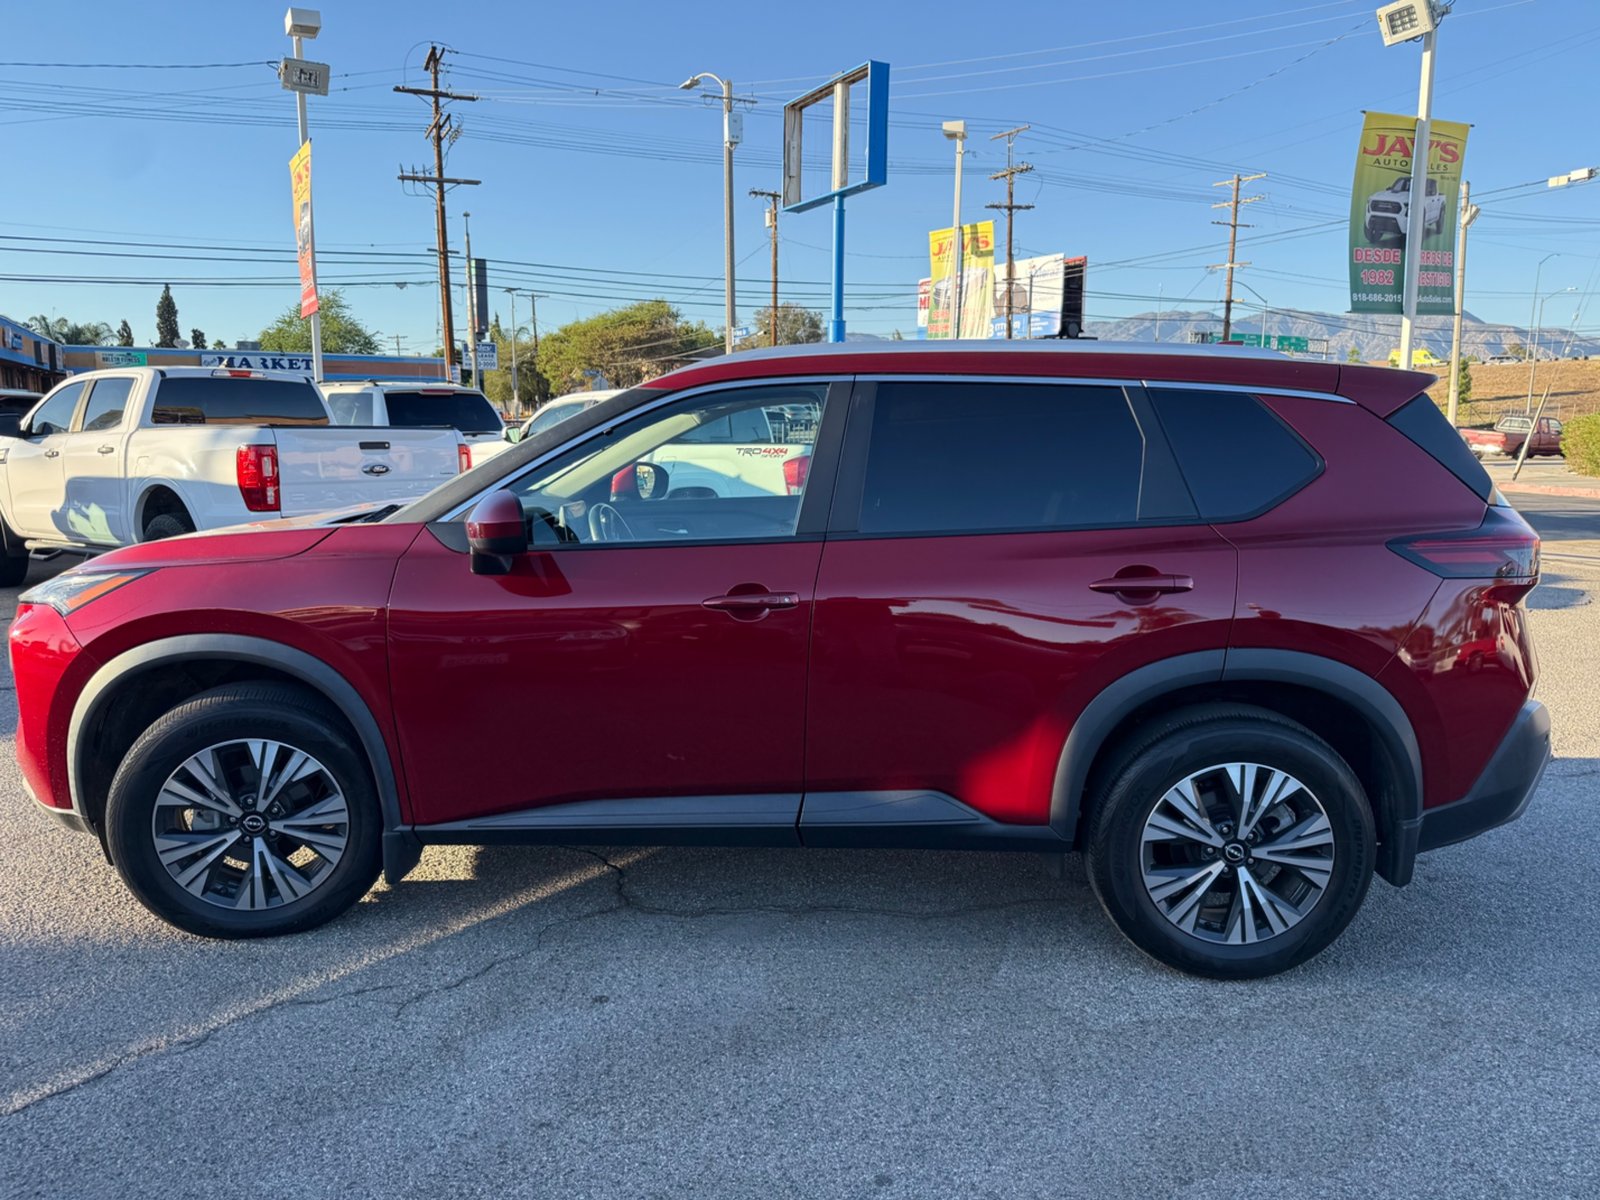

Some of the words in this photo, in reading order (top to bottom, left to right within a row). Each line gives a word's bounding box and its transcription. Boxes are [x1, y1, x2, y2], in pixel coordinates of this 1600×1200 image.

[1373, 158, 1409, 168] AUTO
[1427, 163, 1449, 171] LES
[1354, 248, 1401, 263] DESDE
[1420, 250, 1441, 266] RROS
[1361, 268, 1394, 285] 1982
[1419, 272, 1451, 287] ESTIGIO
[1352, 292, 1402, 303] 818-686-2015
[217, 356, 314, 370] MARKET
